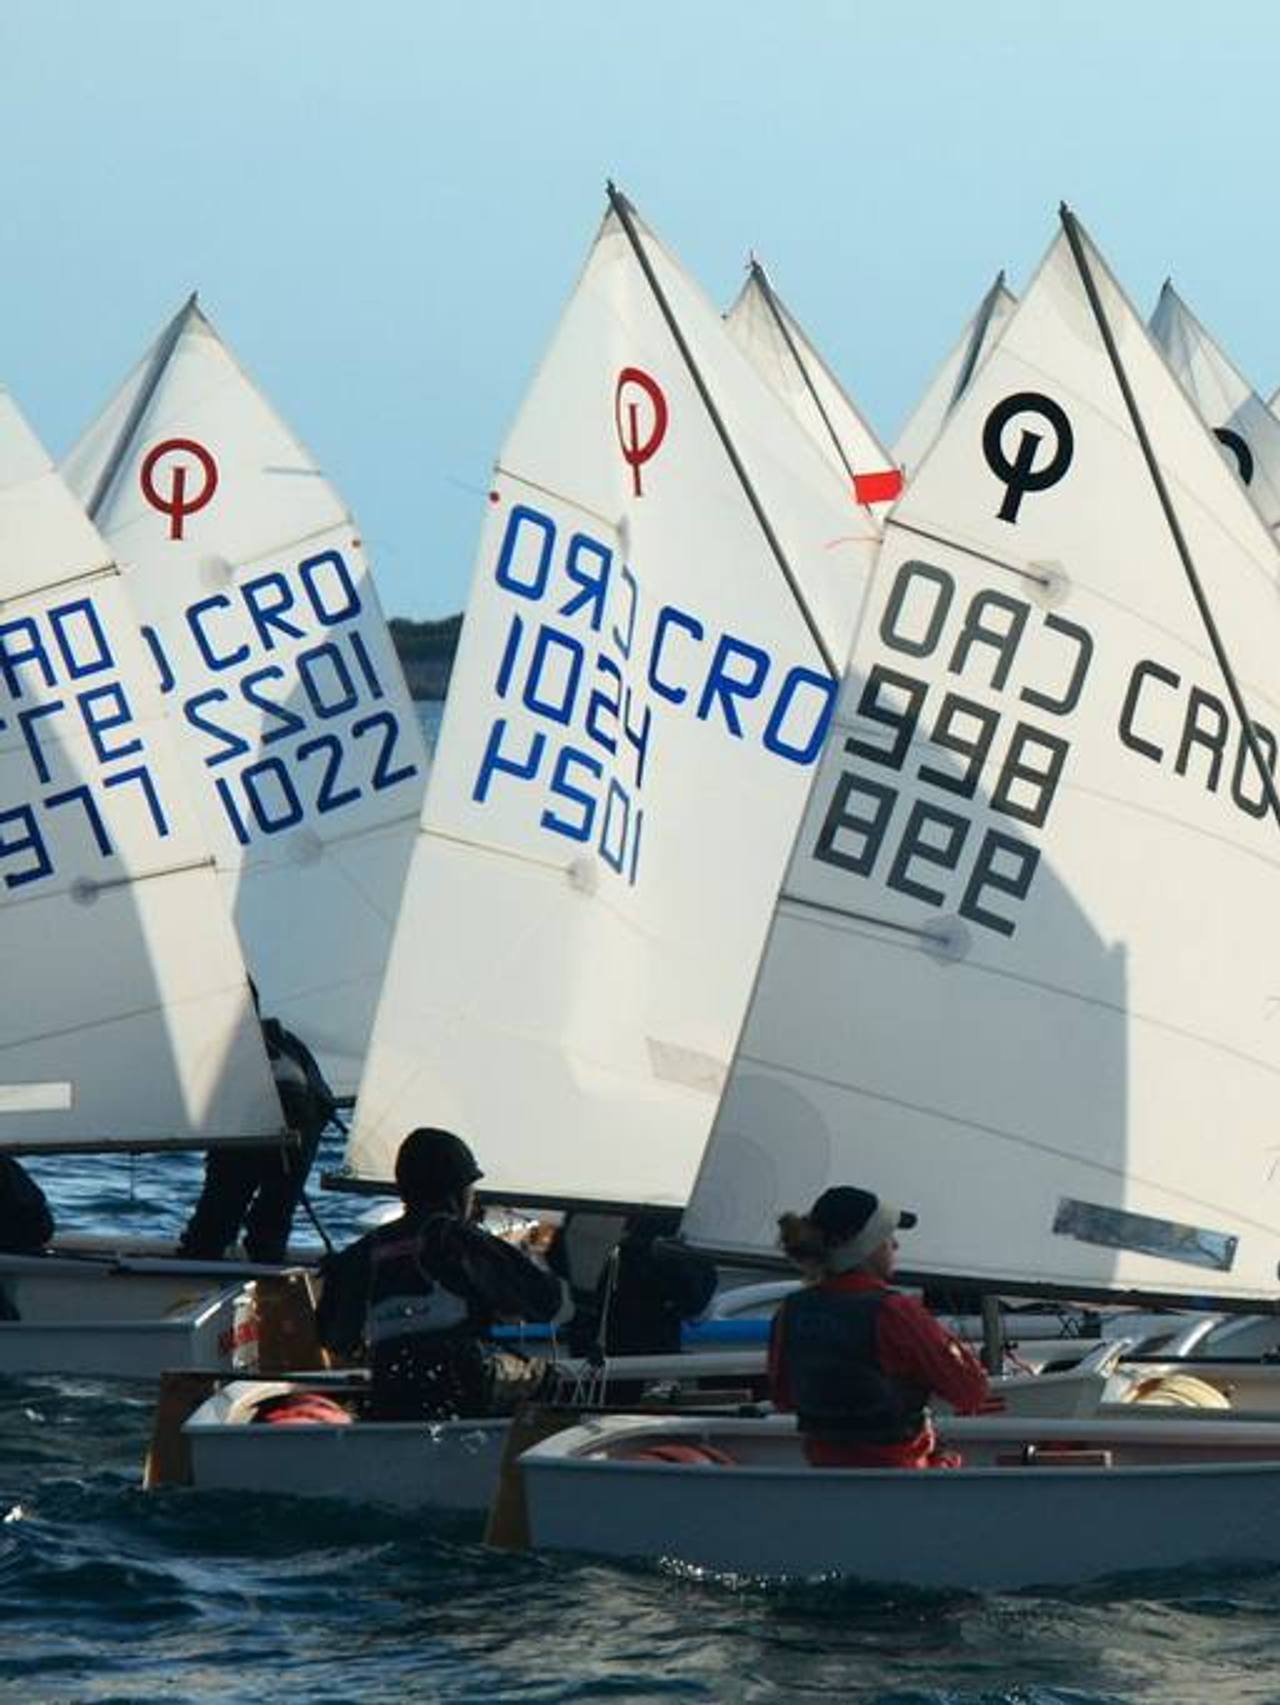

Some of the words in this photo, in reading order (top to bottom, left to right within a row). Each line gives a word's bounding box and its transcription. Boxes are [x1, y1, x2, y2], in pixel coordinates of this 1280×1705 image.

[186, 550, 361, 672] CRO
[648, 605, 840, 766] CRO
[844, 664, 1072, 829] 998
[215, 710, 418, 845] 1022
